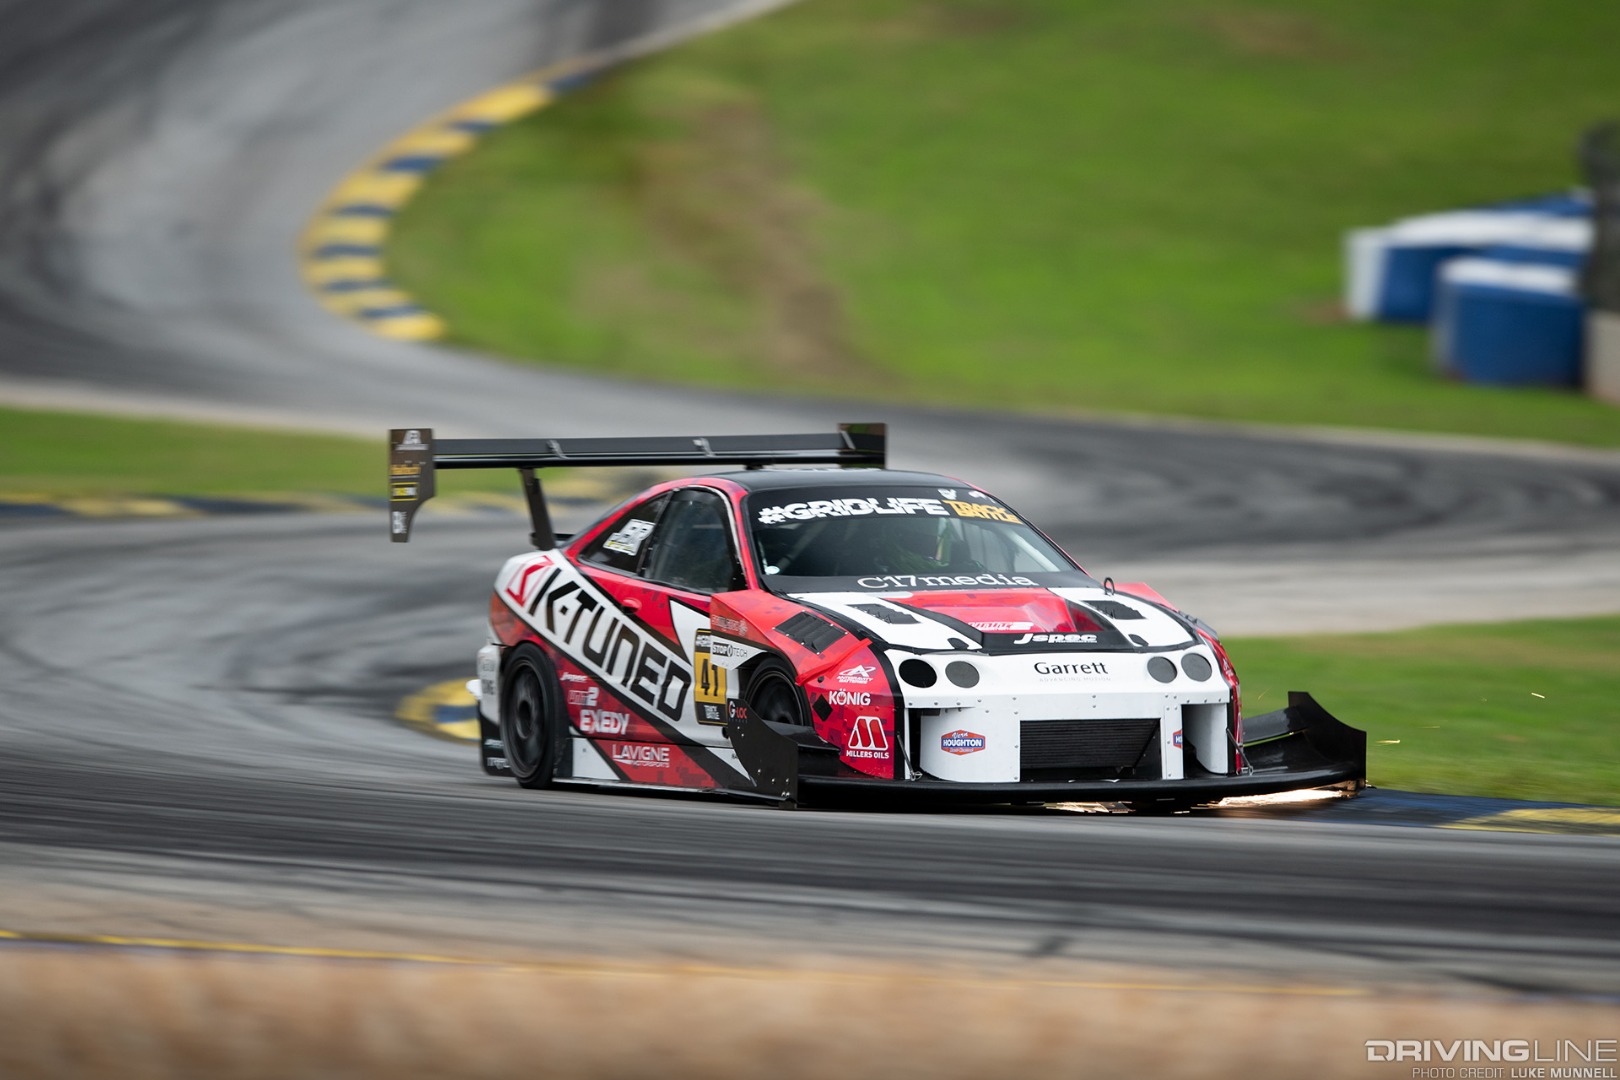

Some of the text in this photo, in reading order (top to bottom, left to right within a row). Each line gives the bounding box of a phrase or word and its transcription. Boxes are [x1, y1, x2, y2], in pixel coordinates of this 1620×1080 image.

[758, 497, 950, 524] #GRIDLIFE
[857, 573, 1039, 589] C17media
[1033, 661, 1109, 675] Garrett
[700, 658, 719, 697] 41
[829, 688, 871, 706] KÖNIG
[580, 709, 630, 735] EXEDY
[942, 739, 982, 747] HOUGHTON
[612, 744, 670, 762] LAVIGNE
[846, 749, 890, 759] MILLERS OILS
